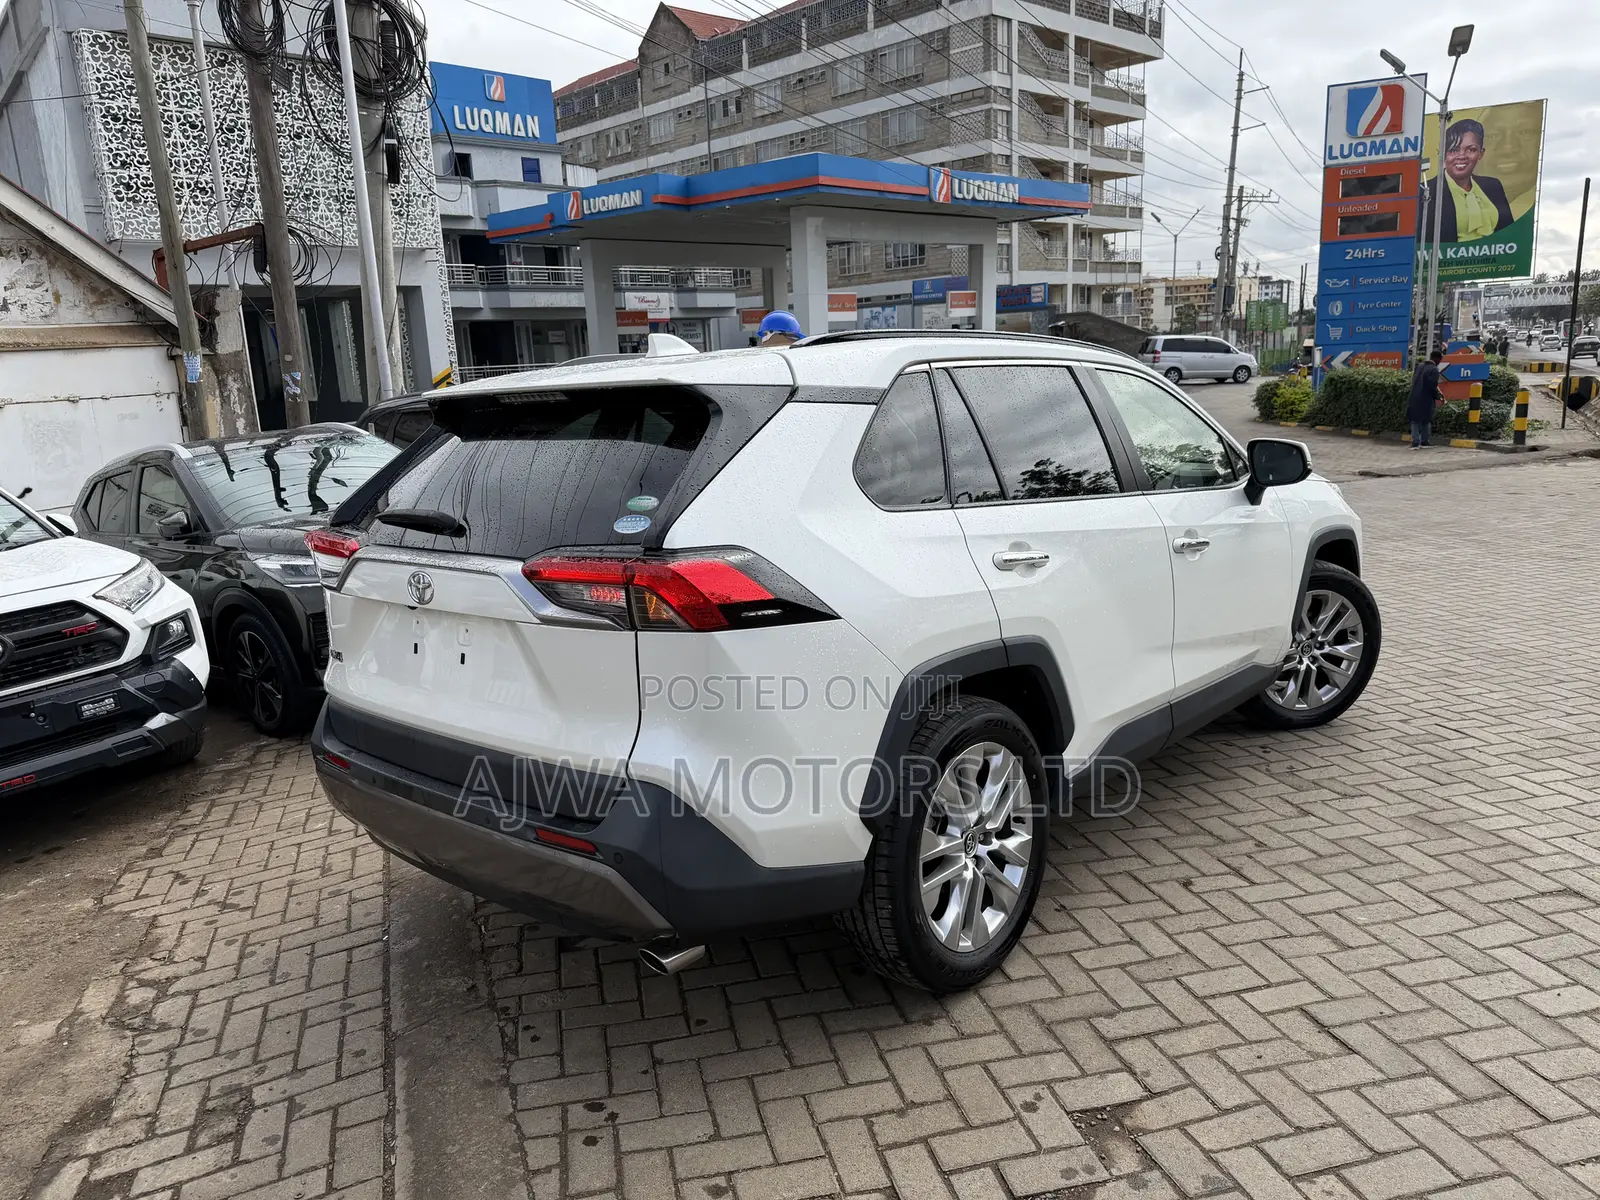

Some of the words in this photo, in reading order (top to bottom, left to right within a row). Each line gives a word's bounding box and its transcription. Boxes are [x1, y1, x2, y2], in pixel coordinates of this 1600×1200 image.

[453, 105, 540, 138] LUQMAN
[1328, 136, 1419, 160] LUQMAN
[1340, 166, 1366, 176] Diesel
[952, 178, 1019, 203] LUQMAN
[583, 190, 642, 215] LUQMAN
[1338, 203, 1378, 213] Unleaded
[1344, 248, 1385, 260] 24Hrs
[1446, 242, 1518, 259] KANAIRO
[1498, 264, 1516, 272] 2027
[1359, 276, 1390, 285] Service
[1392, 275, 1408, 284] Bay
[1358, 302, 1375, 311] Tyre
[1376, 301, 1402, 309] Center
[1379, 324, 1398, 333] Shop
[1460, 367, 1471, 377] In
[61, 621, 98, 637] TRD
[0, 774, 36, 789] TRD
